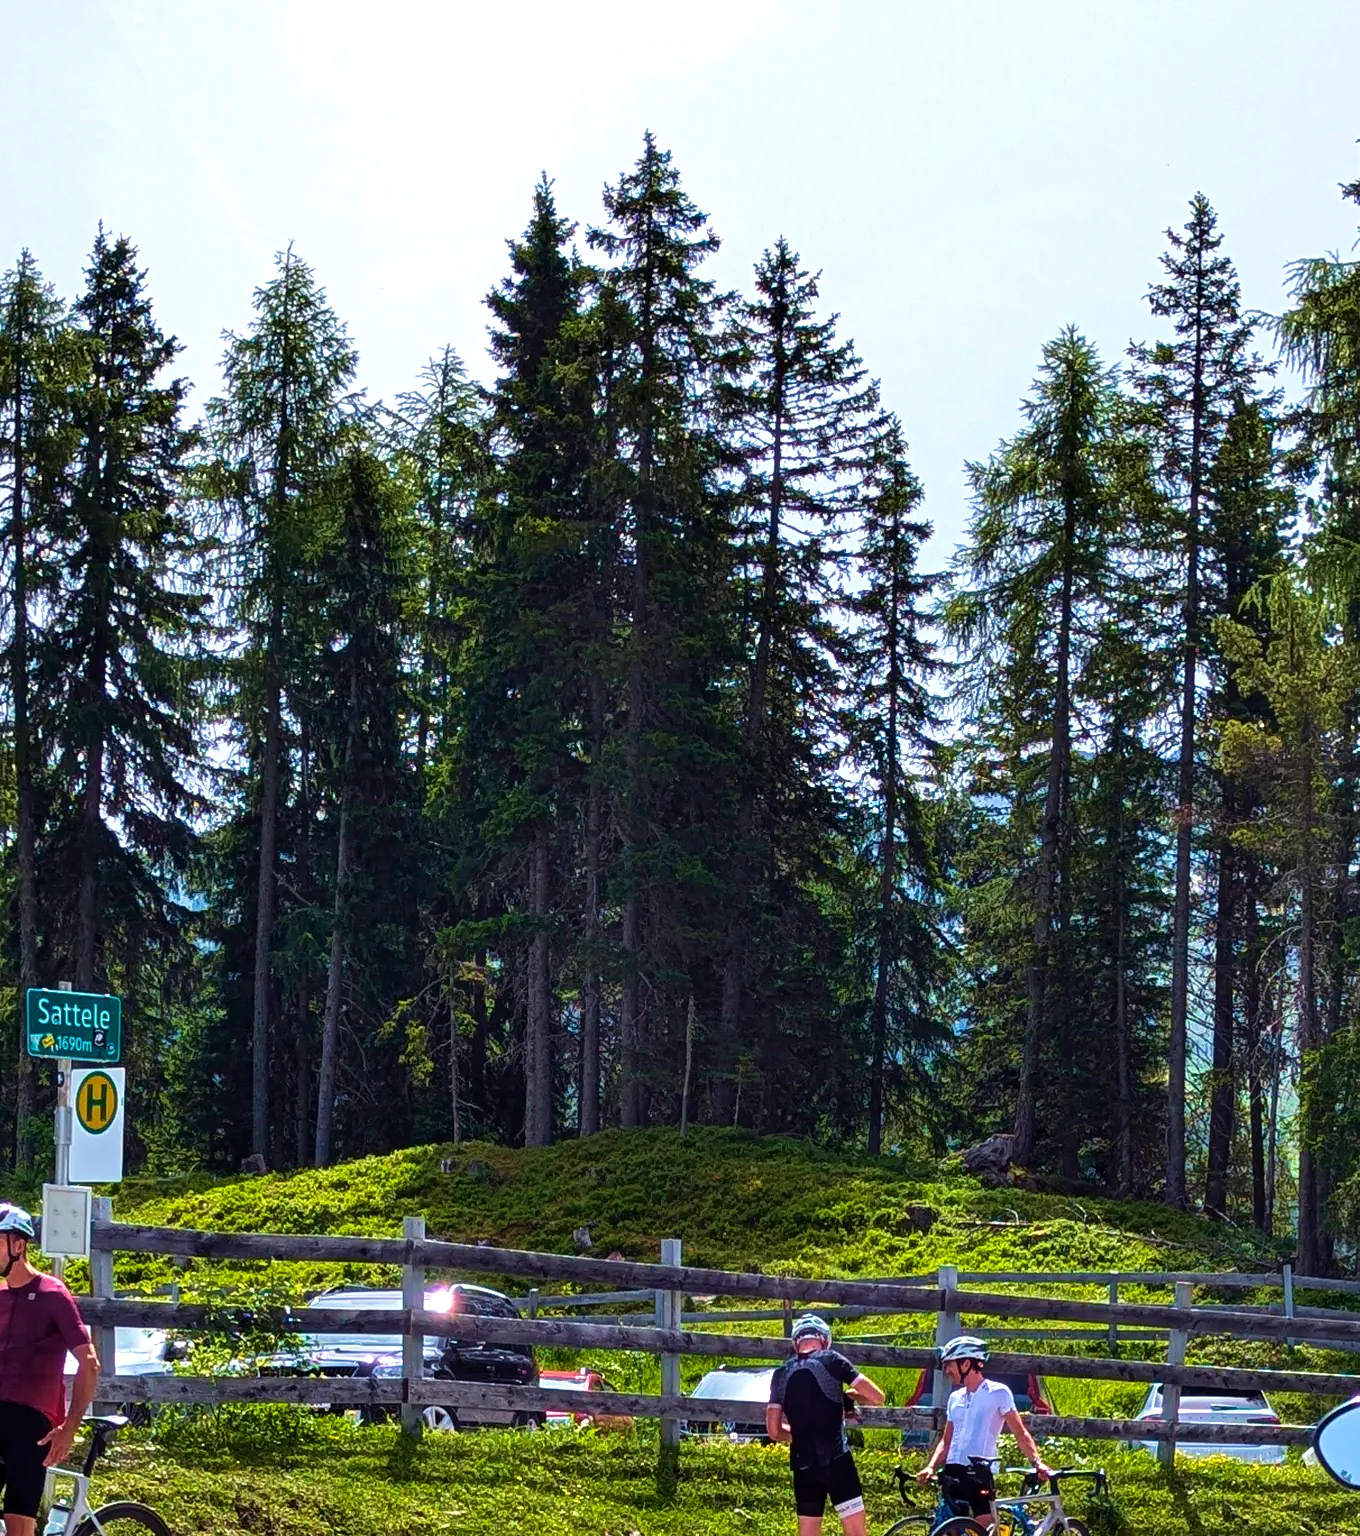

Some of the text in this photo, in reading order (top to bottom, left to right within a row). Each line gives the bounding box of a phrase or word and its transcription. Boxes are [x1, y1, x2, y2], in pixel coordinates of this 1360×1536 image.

[38, 998, 111, 1030] Sattele
[56, 1036, 92, 1052] 1690m
[86, 1083, 108, 1122] H
